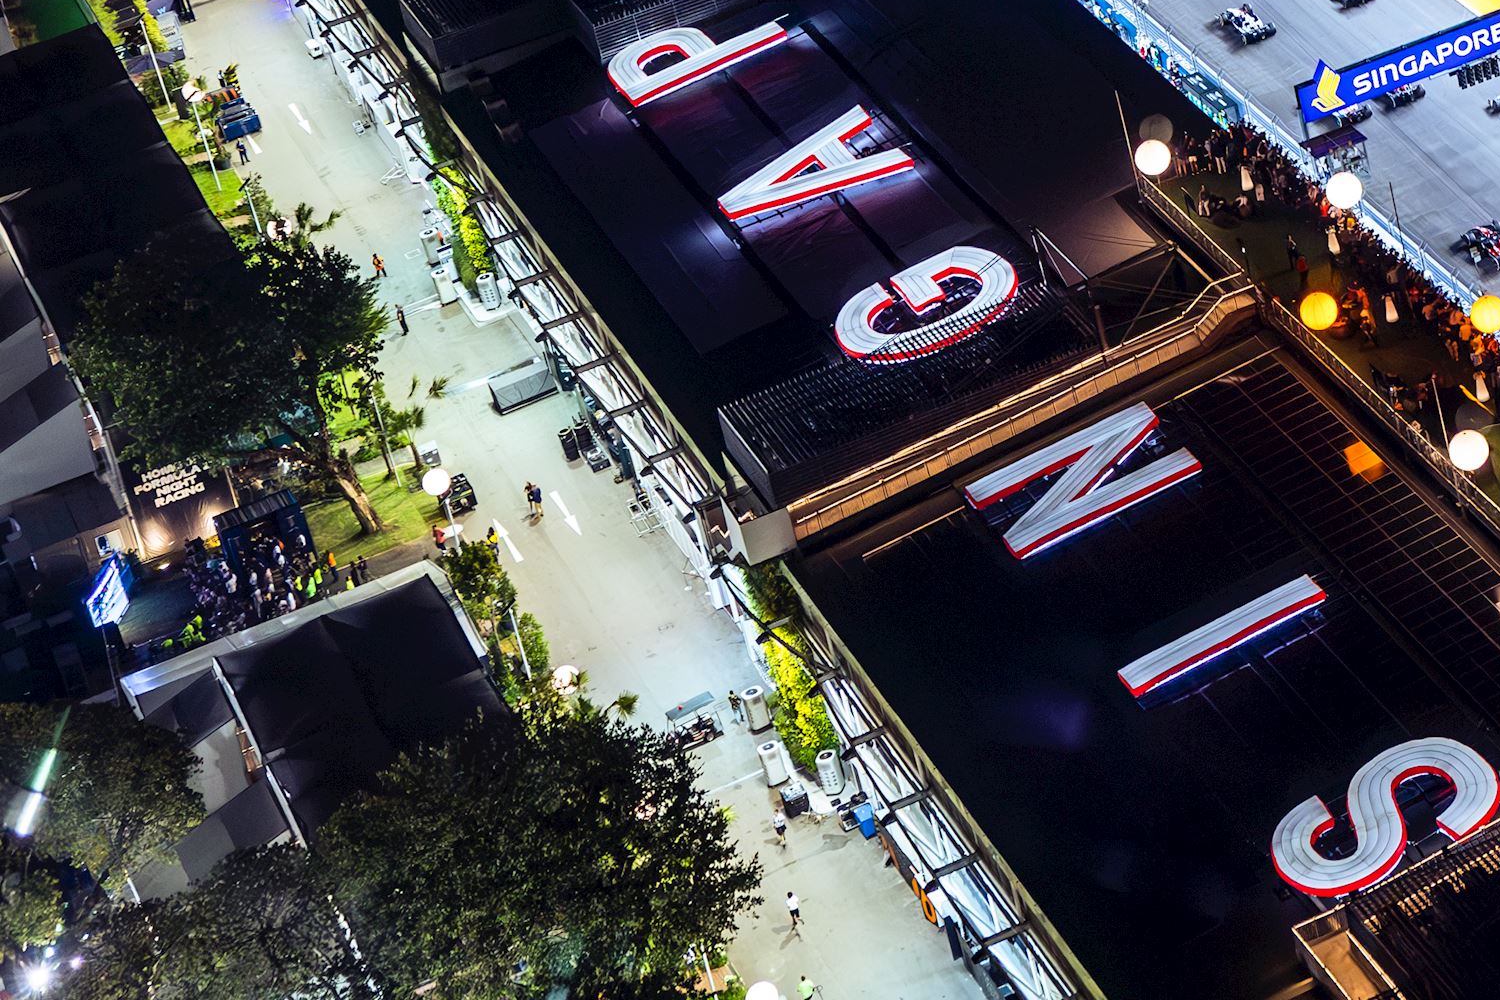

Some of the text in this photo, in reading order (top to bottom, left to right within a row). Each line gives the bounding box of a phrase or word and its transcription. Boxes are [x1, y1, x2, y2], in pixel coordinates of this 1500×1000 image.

[134, 465, 201, 495] FORMULA
[156, 475, 197, 497] NIGHT
[154, 481, 205, 508] RACING
